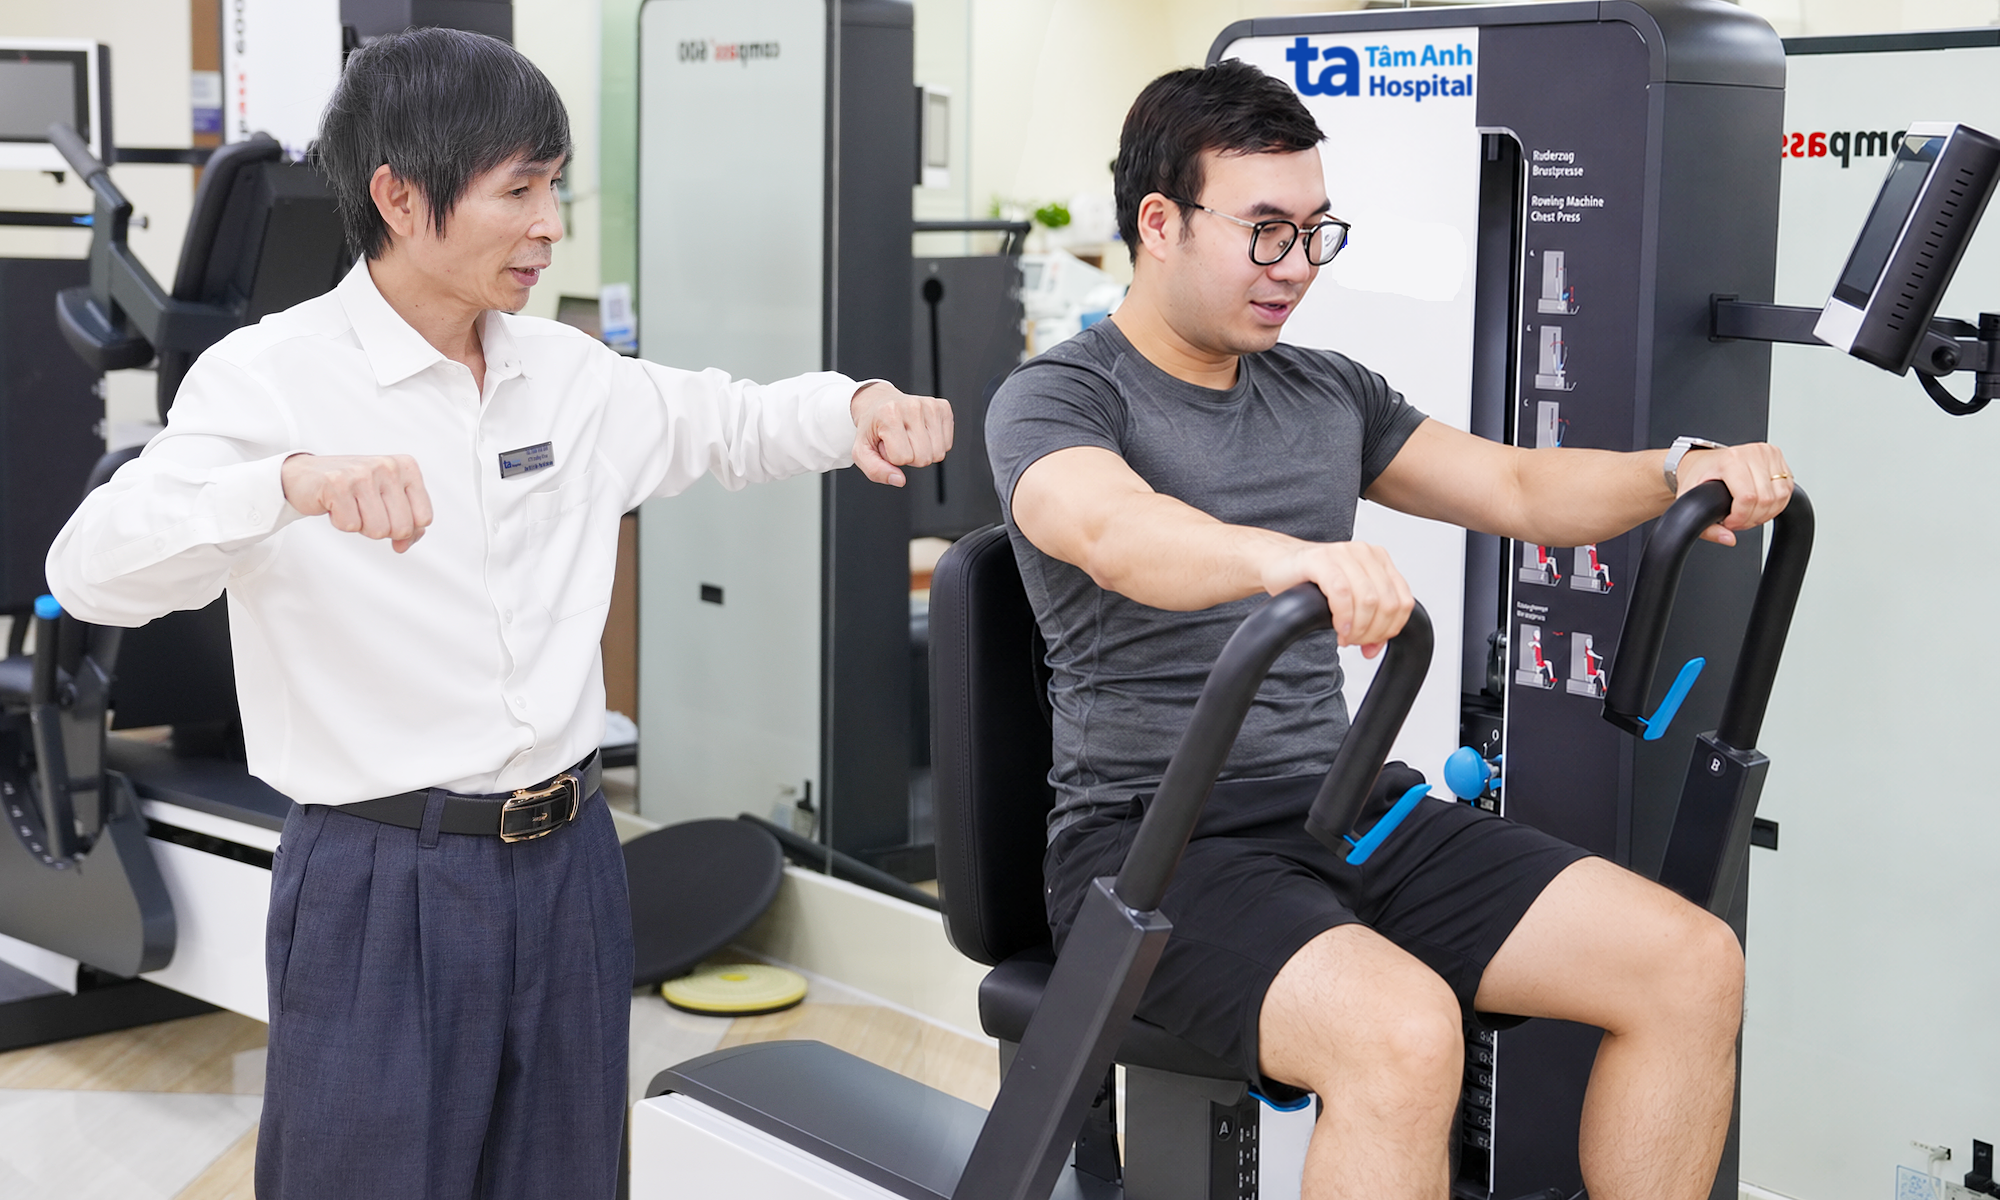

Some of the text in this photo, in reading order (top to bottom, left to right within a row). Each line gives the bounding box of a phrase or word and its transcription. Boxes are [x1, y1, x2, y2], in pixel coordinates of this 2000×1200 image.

[1364, 44, 1473, 68] Tâm Anh
[1286, 37, 1360, 97] ta
[1369, 74, 1473, 102] Hospital
[1531, 195, 1604, 210] Rowing Machine
[1530, 210, 1581, 223] Chest Press
[1710, 757, 1721, 772] B
[1218, 1121, 1229, 1136] A
